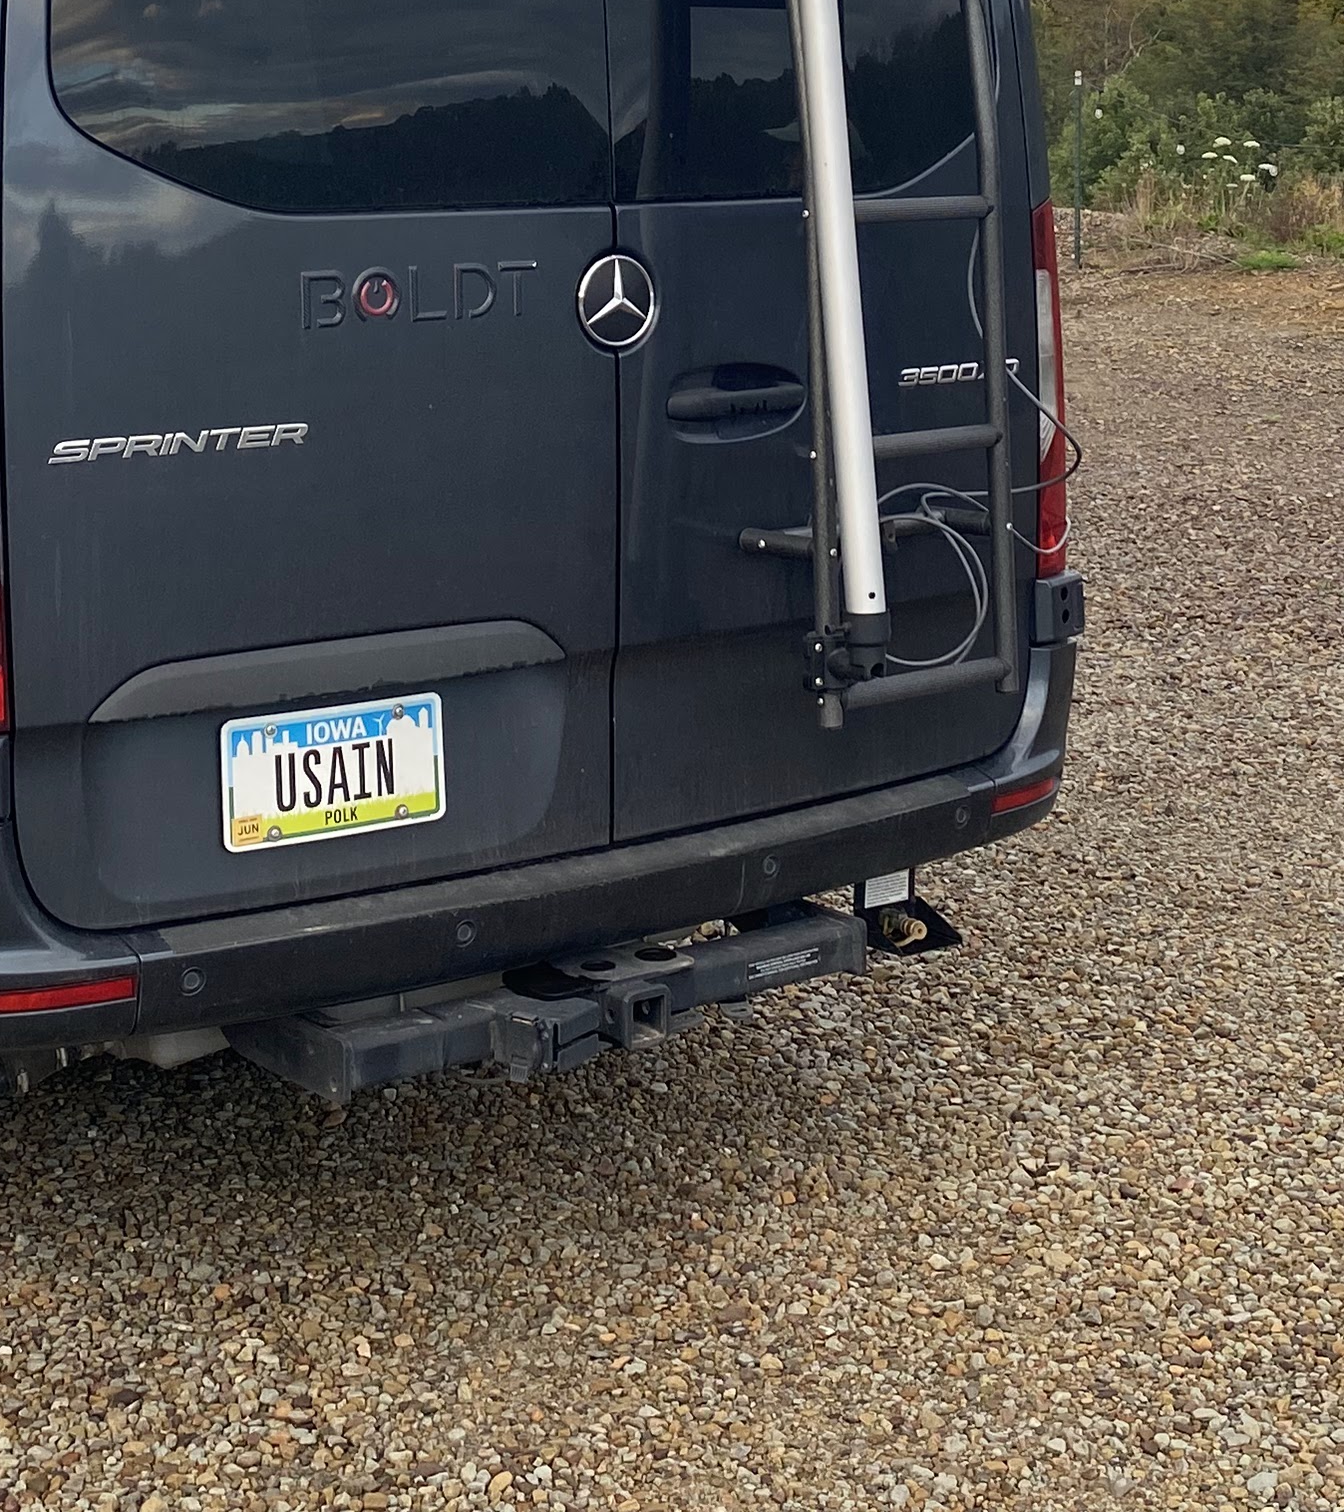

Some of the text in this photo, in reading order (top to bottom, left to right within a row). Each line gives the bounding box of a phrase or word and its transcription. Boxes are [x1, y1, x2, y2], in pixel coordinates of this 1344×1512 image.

[300, 260, 538, 329] BOLDT
[47, 422, 309, 465] SPRINTER
[306, 716, 367, 745] IOWA
[274, 738, 396, 812] USAIN
[237, 823, 259, 836] JUN
[324, 806, 358, 826] POLK
